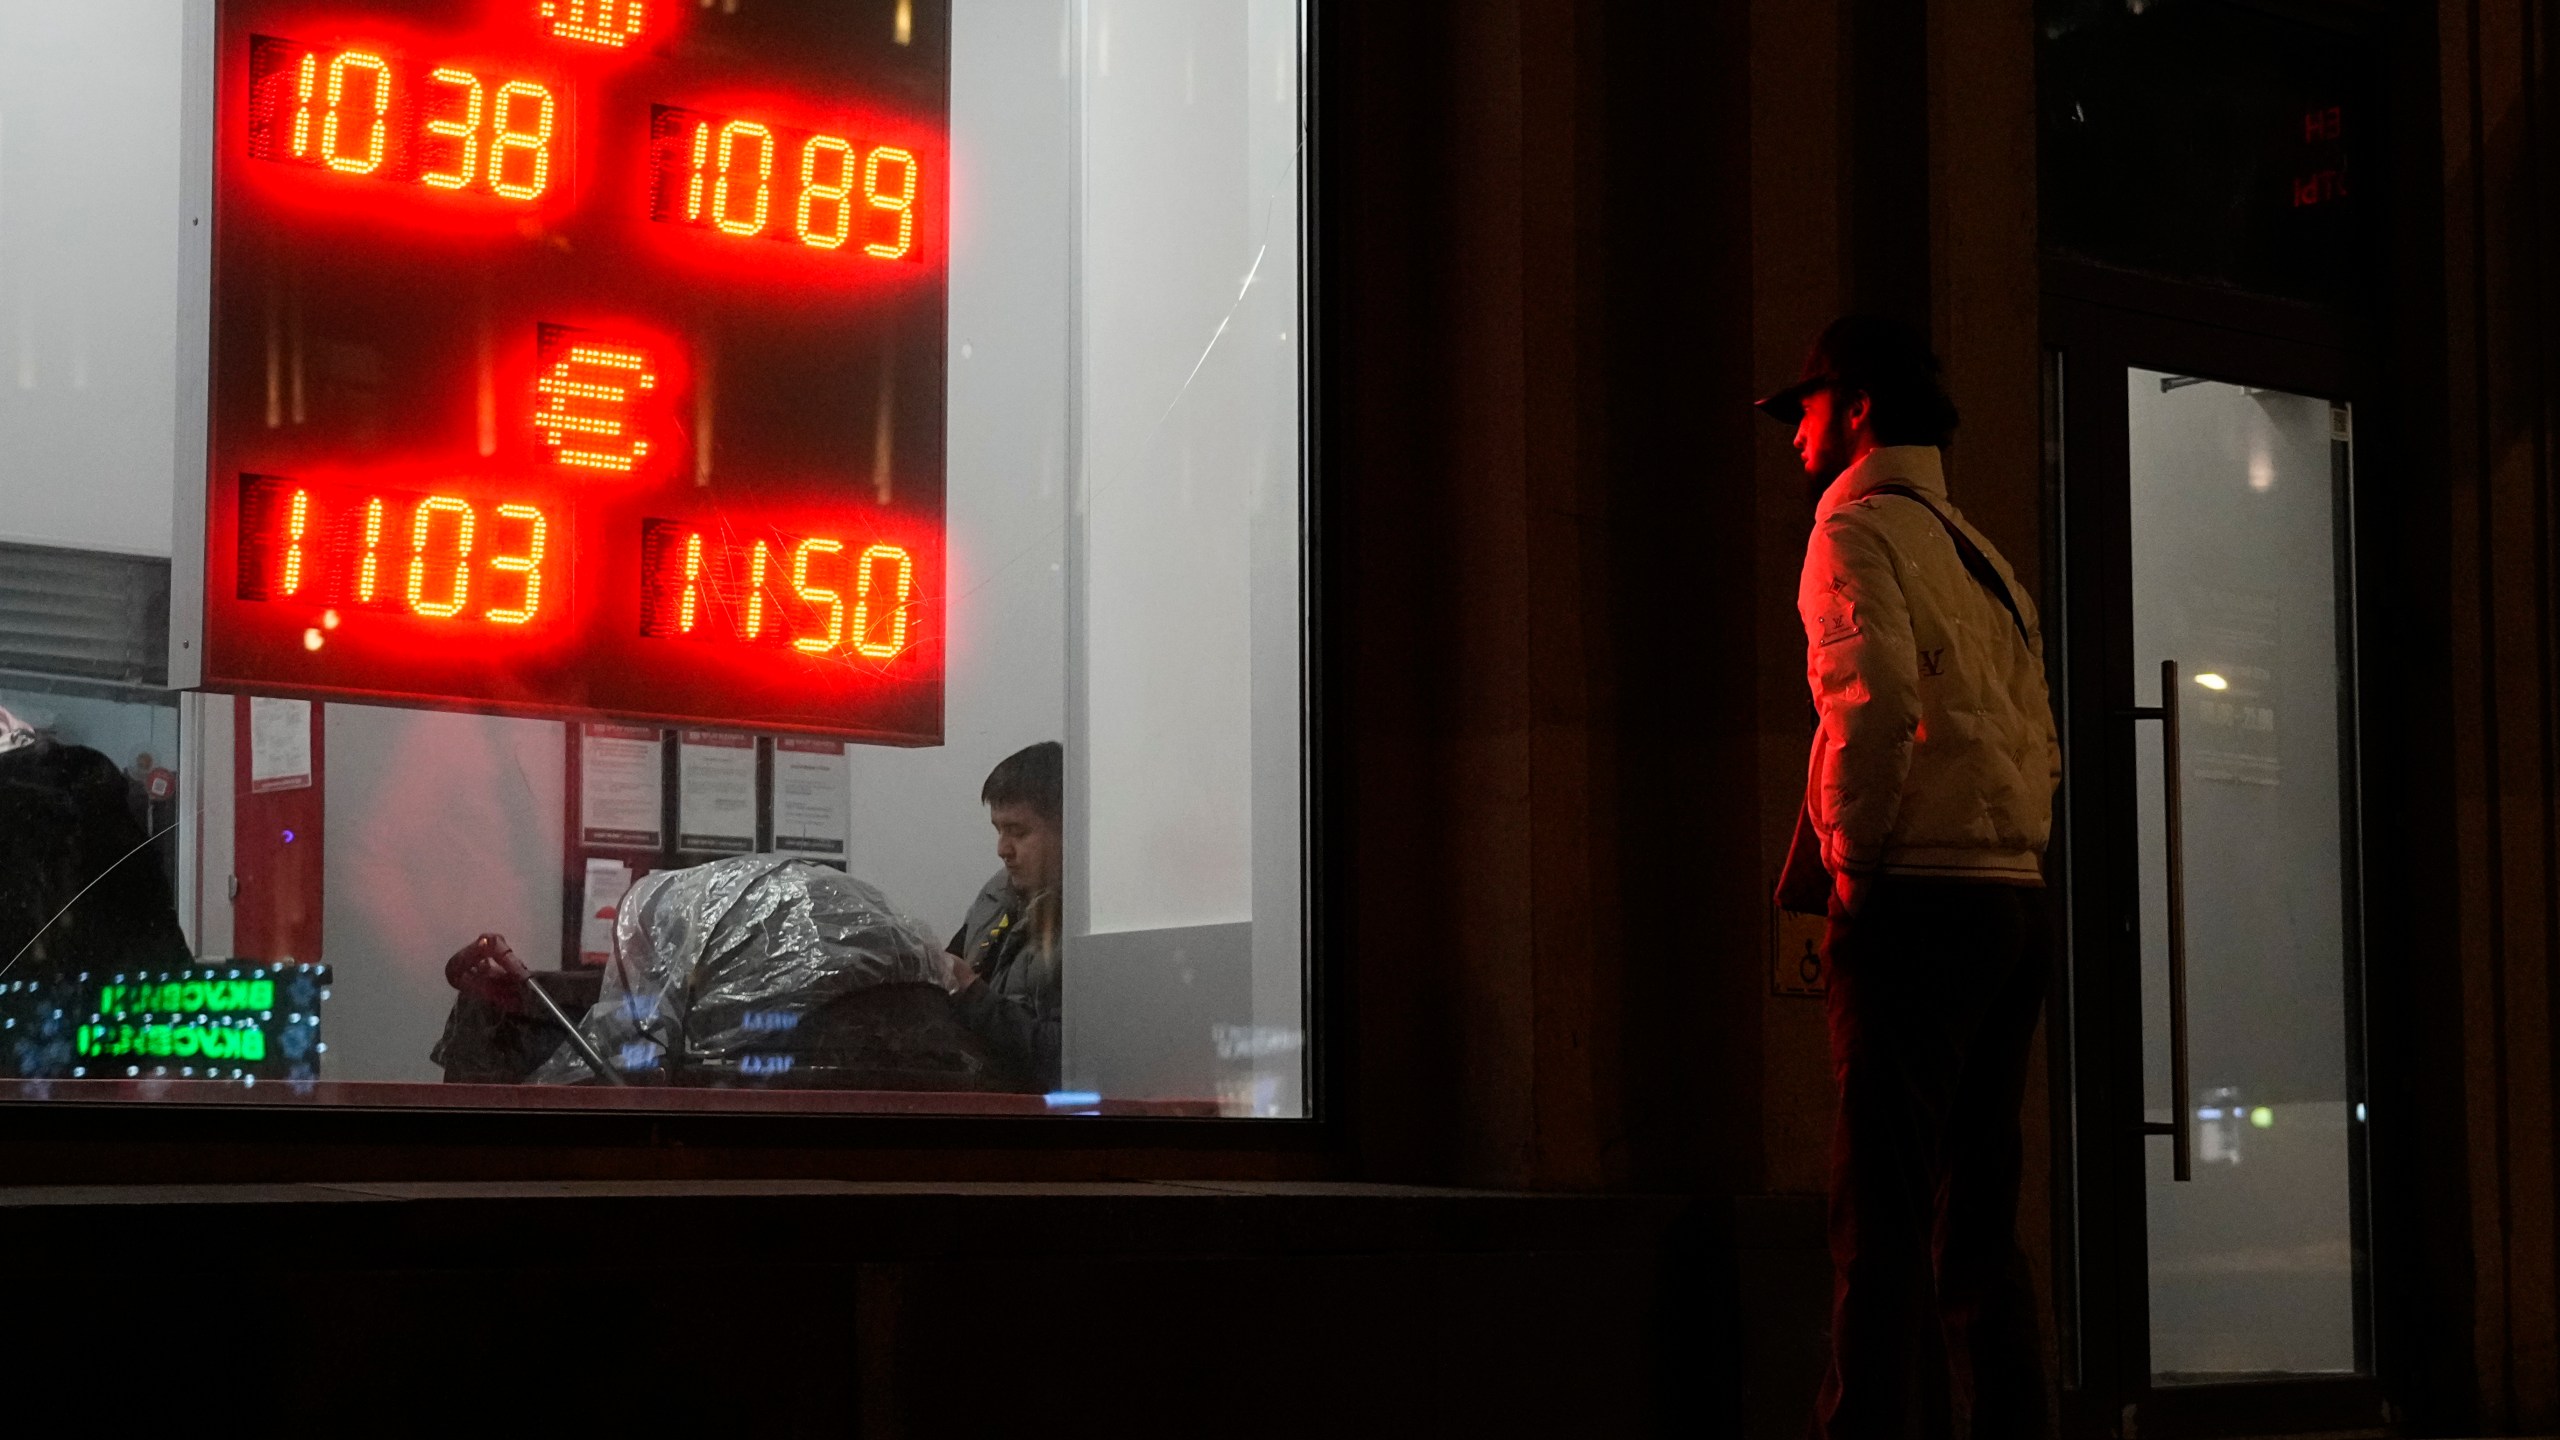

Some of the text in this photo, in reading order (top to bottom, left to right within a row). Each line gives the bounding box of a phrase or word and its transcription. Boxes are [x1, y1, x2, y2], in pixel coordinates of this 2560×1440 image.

[535, 346, 655, 472] €
[284, 489, 547, 625] 1103
[680, 533, 912, 658] 1150
